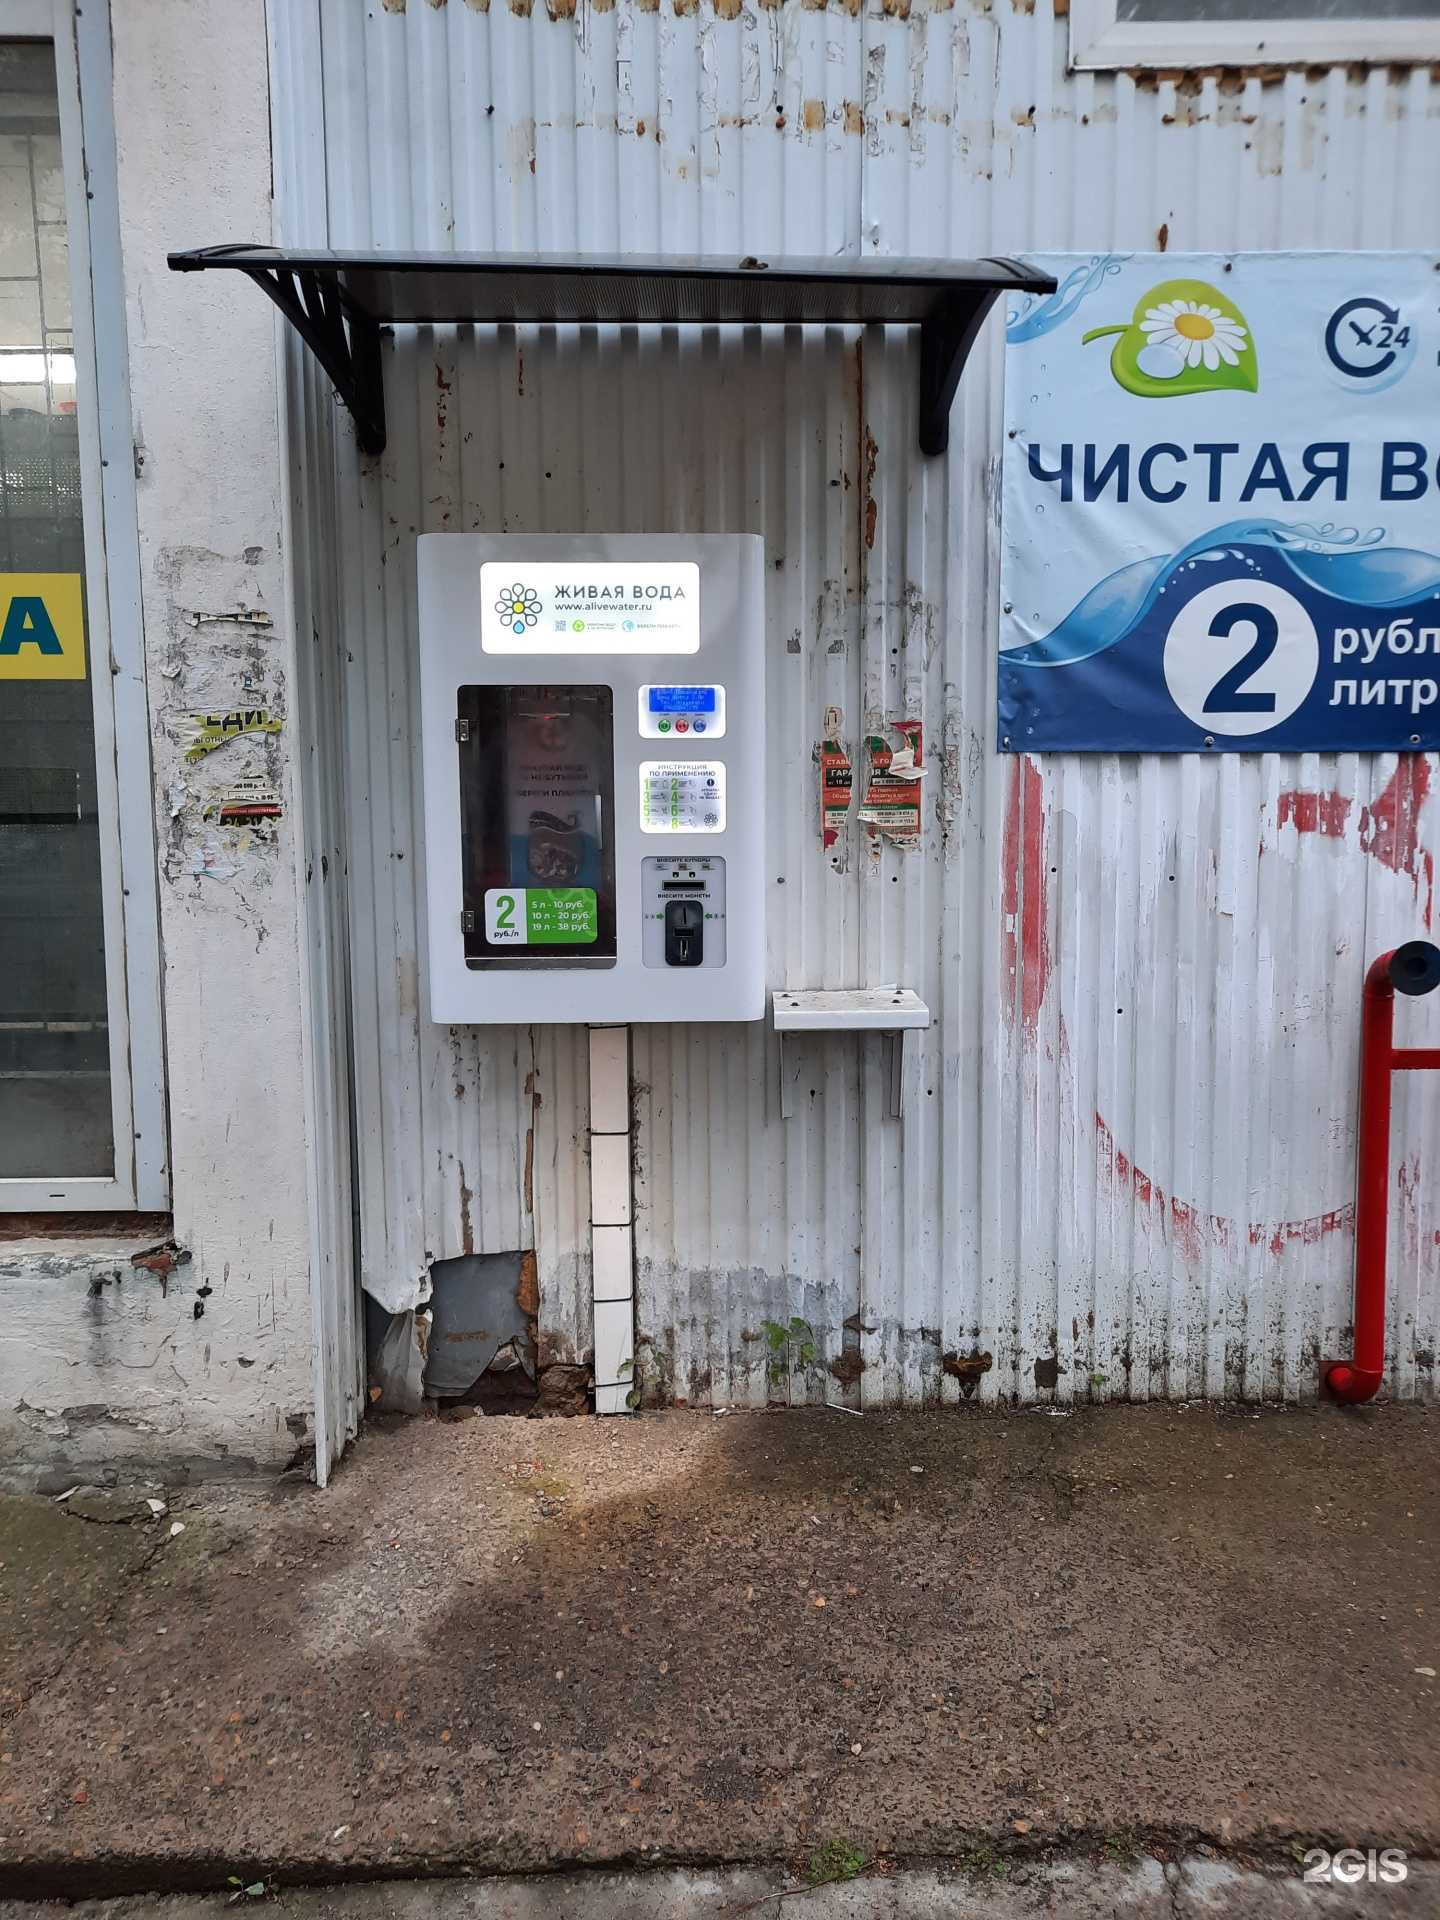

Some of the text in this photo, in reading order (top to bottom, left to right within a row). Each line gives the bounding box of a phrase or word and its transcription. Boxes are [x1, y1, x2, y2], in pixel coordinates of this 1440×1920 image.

[1376, 326, 1411, 349] 24
[1028, 441, 1440, 504] ЧИСТАЯ В
[555, 585, 686, 601] ЖИВАЯ ВОДА
[555, 602, 653, 611] www.alivewater.ru
[1333, 618, 1440, 664] рубл
[1202, 603, 1279, 714] 2
[1329, 679, 1438, 714] литр
[671, 778, 679, 790] 2
[671, 792, 679, 803] 4
[671, 805, 679, 817] 6
[496, 895, 516, 929] 2
[566, 901, 585, 910] руб.
[572, 911, 591, 920] руб.
[572, 922, 591, 932] руб.
